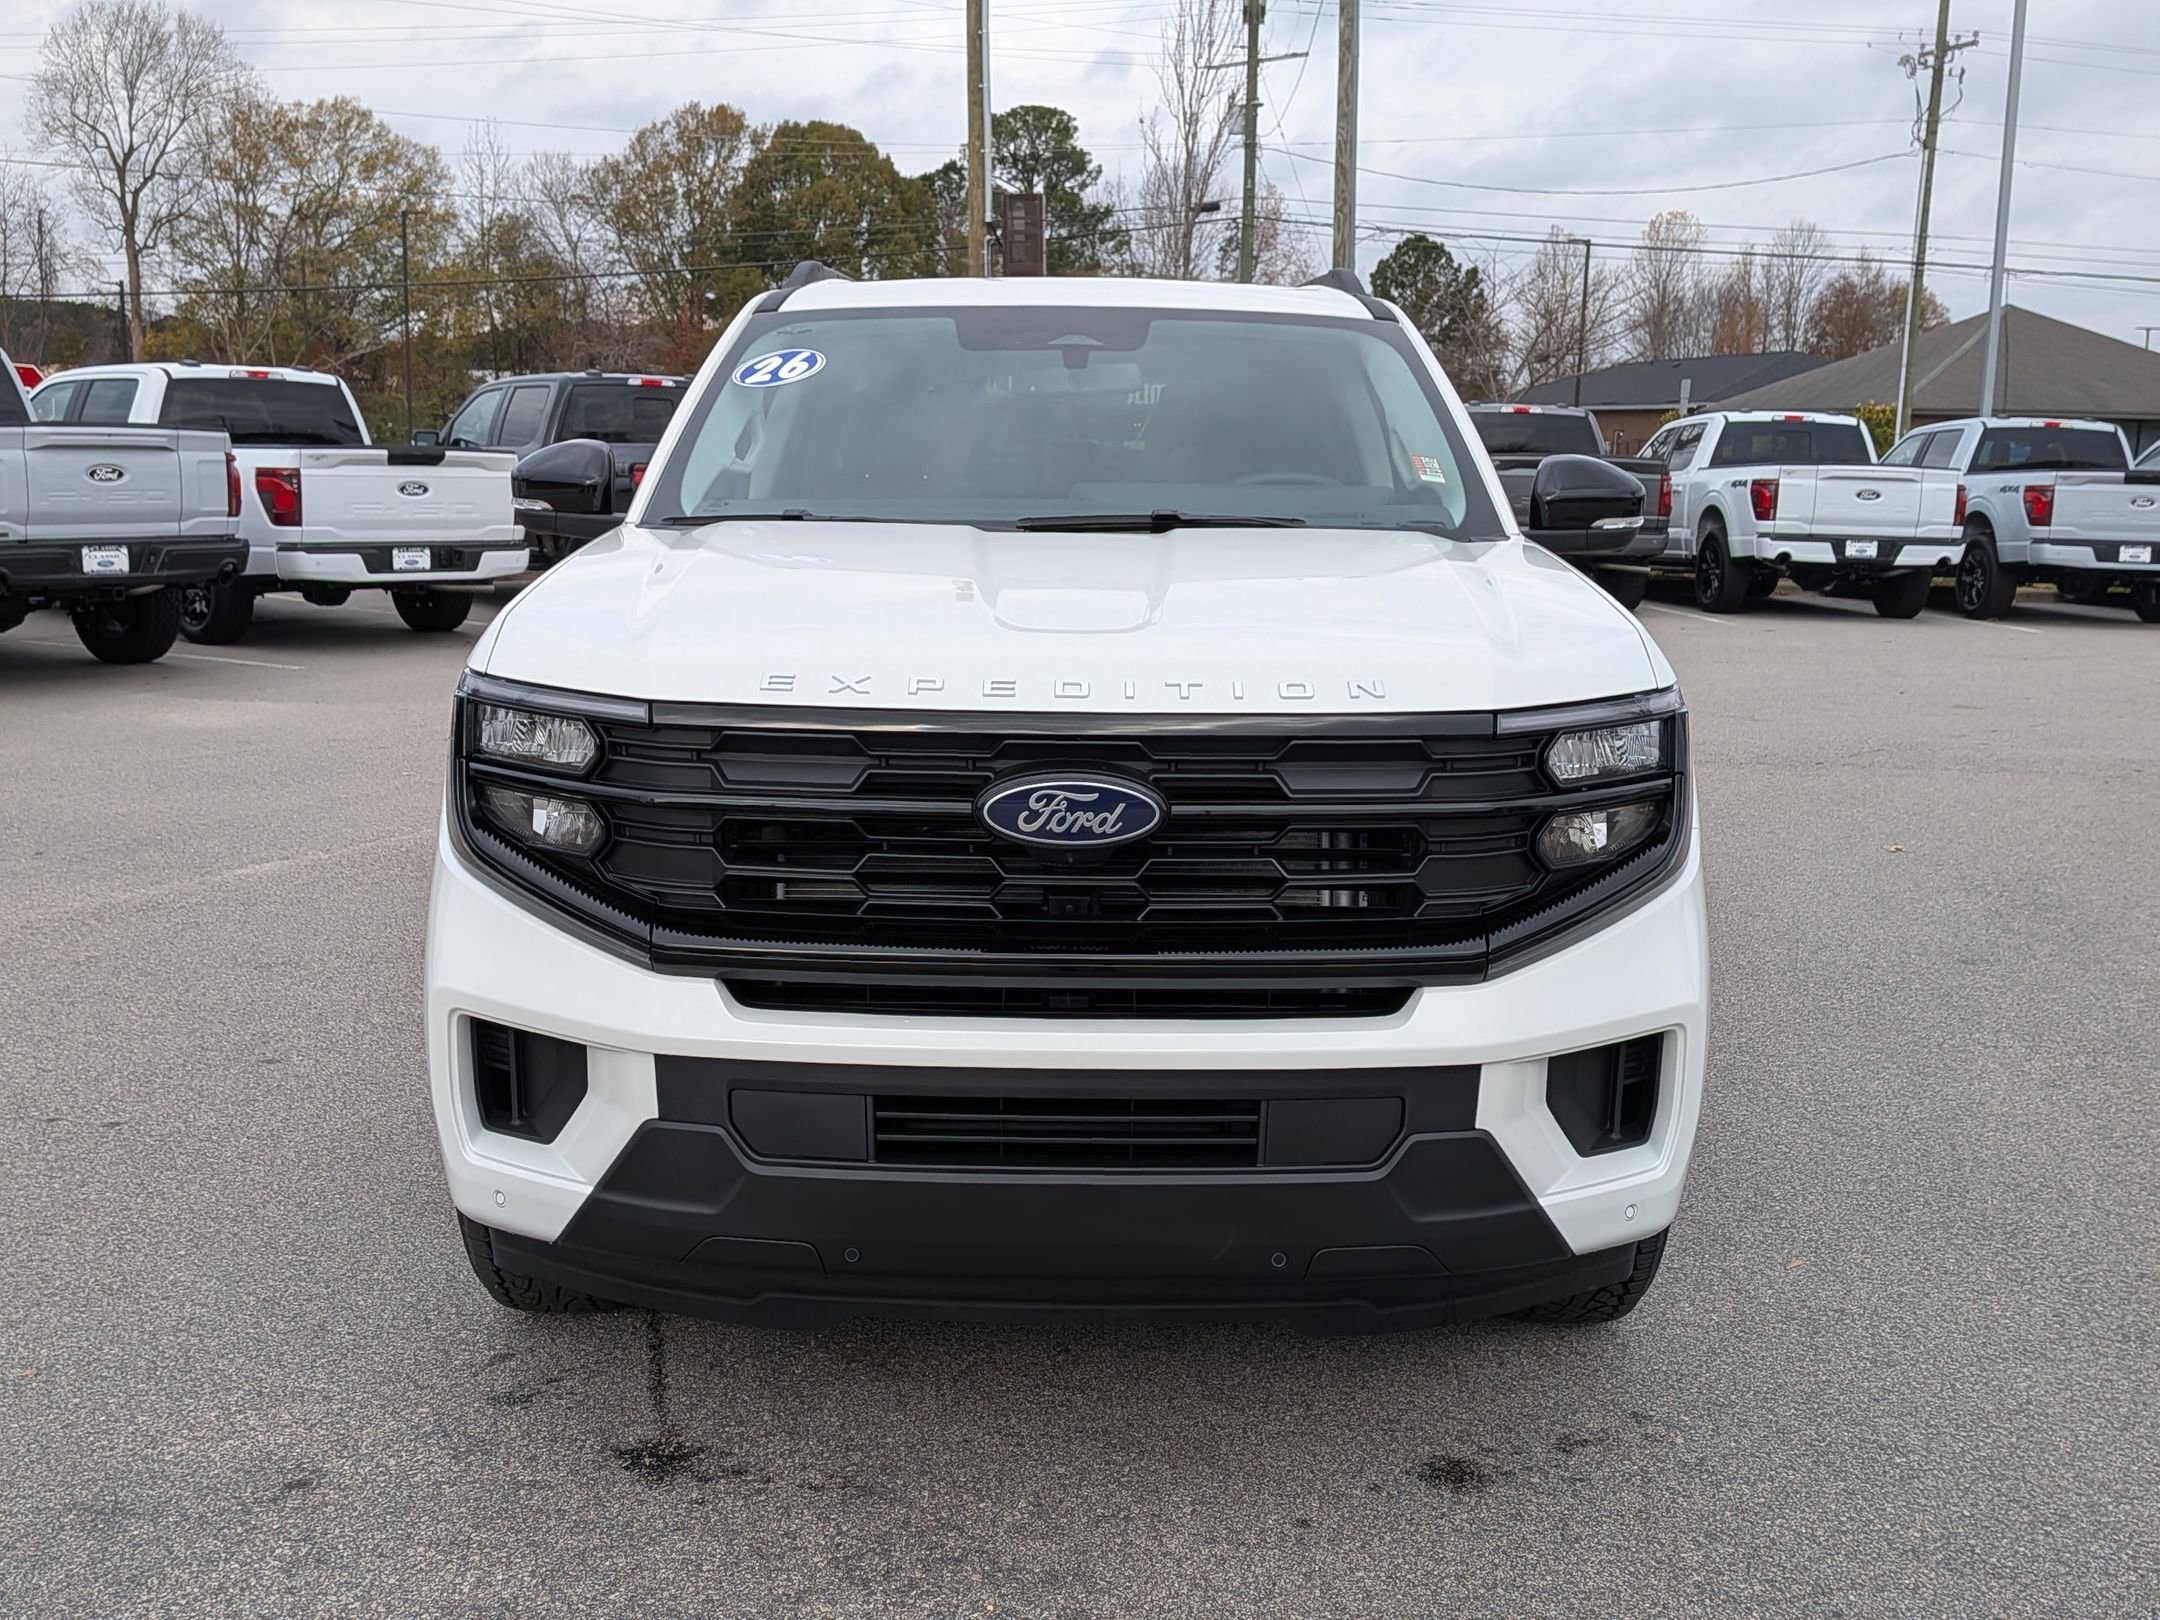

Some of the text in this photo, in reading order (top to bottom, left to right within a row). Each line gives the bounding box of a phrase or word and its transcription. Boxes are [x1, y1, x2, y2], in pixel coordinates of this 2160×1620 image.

[745, 351, 811, 384] 26
[94, 467, 119, 480] Ford
[403, 483, 425, 495] Ford
[758, 672, 1387, 699] EXPEDITION
[1017, 789, 1126, 834] Ford
